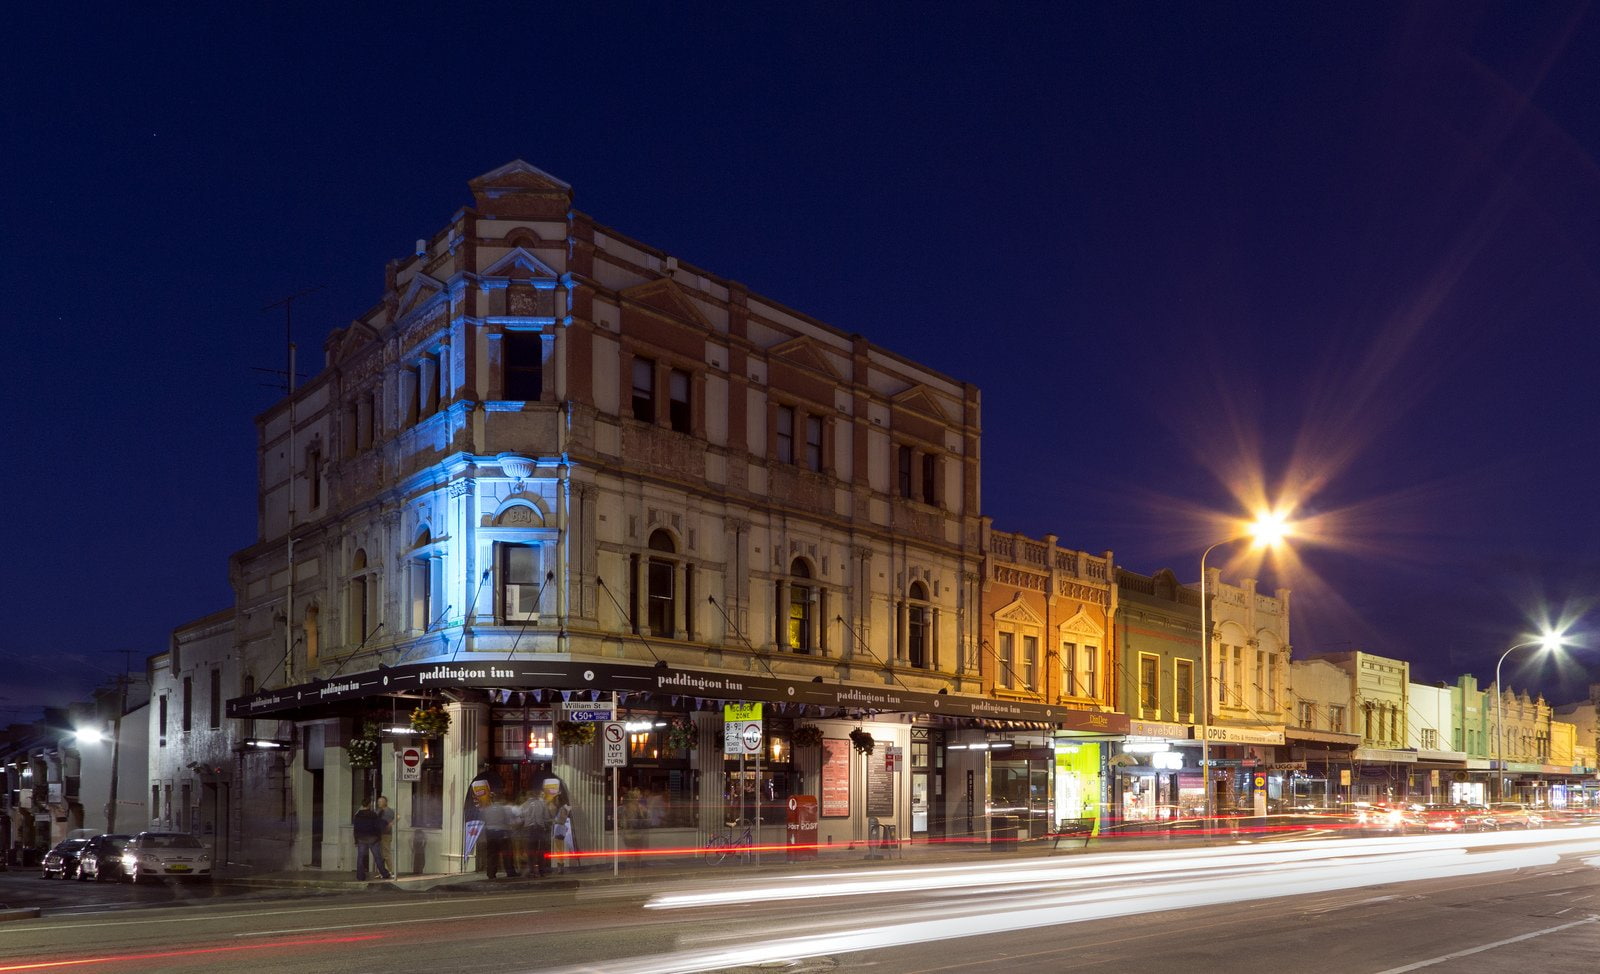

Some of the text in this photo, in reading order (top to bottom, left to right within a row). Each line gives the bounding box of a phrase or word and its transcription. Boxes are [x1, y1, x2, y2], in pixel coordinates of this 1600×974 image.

[419, 666, 514, 684] paddington inn
[658, 673, 743, 691] paddington inn
[321, 680, 360, 699] paddington inn
[837, 689, 901, 704] paddington inn
[971, 702, 1021, 715] paddington inn
[578, 711, 593, 720] 50+
[745, 731, 759, 744] 40
[1208, 728, 1227, 739] OPUS
[801, 822, 819, 830] POST
